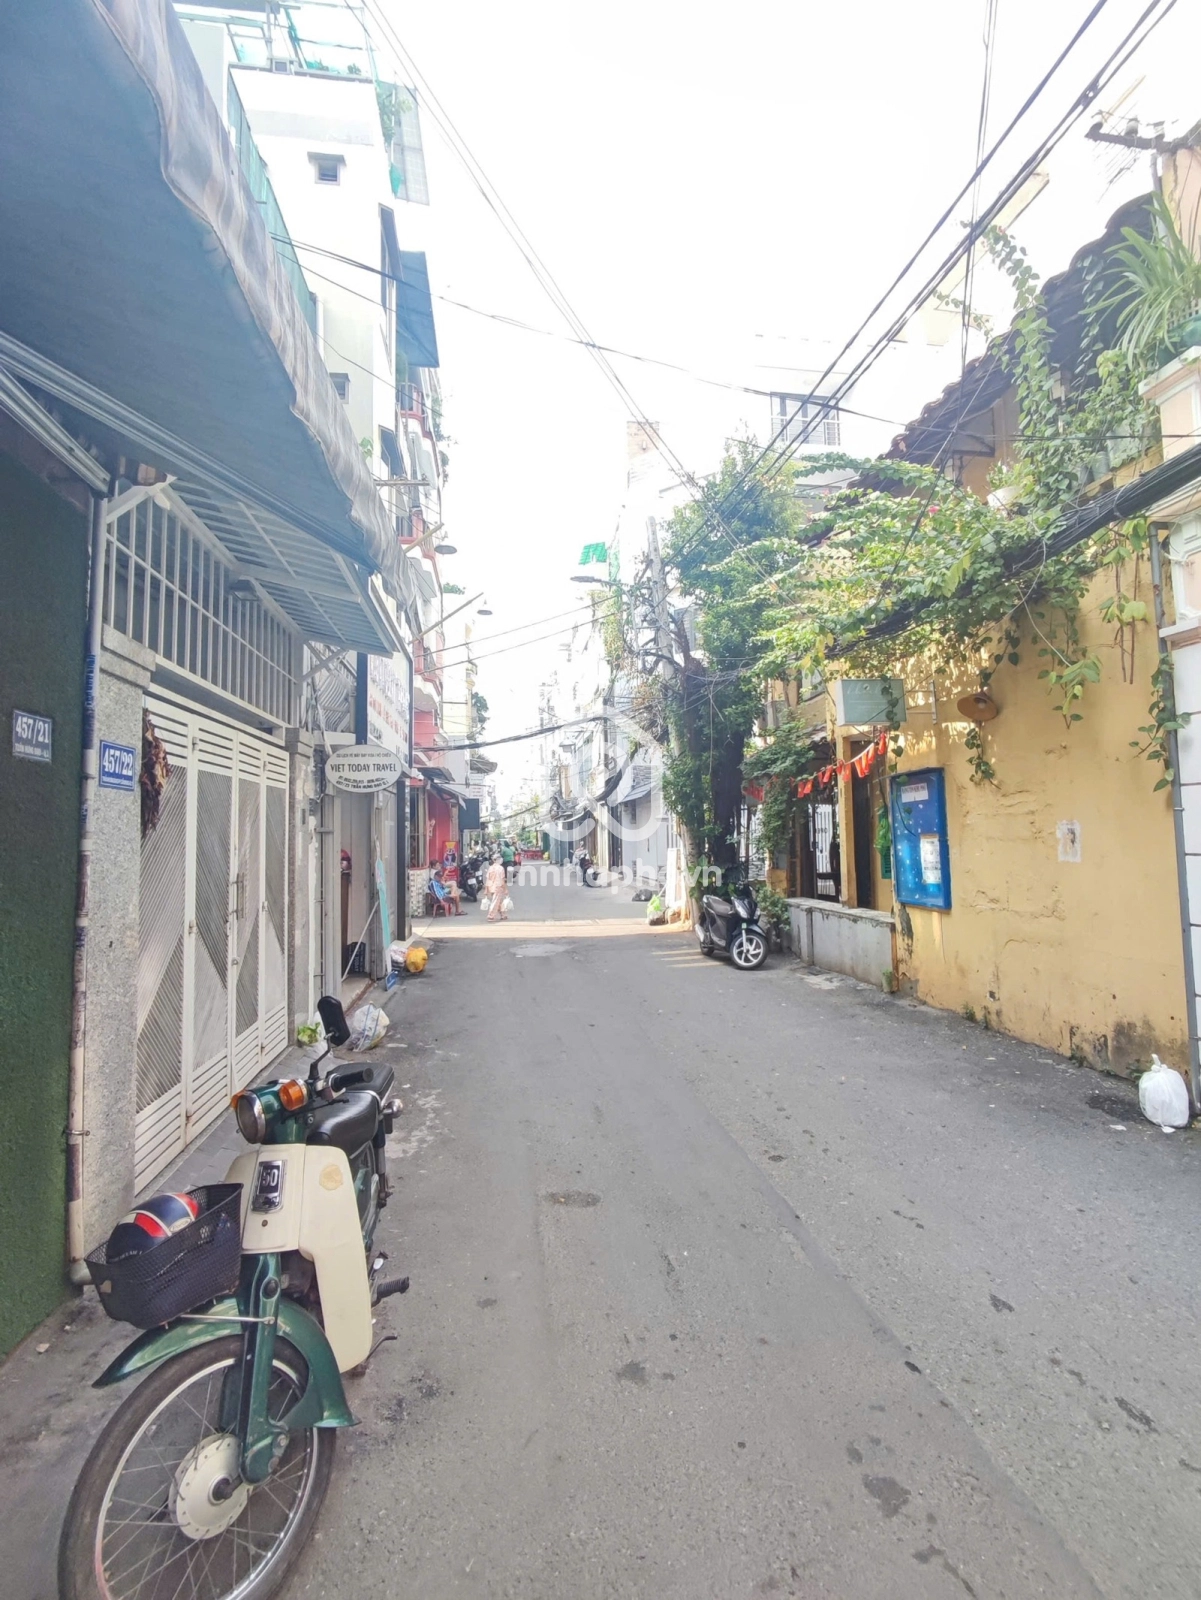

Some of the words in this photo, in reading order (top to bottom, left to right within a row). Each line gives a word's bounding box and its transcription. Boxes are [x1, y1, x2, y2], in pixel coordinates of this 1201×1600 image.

[16, 716, 49, 744] 457/21
[102, 748, 133, 776] 457/22
[330, 763, 346, 773] VIET
[347, 763, 371, 772] TODAY
[372, 763, 397, 772] TRAVEL
[262, 1168, 279, 1187] 50
